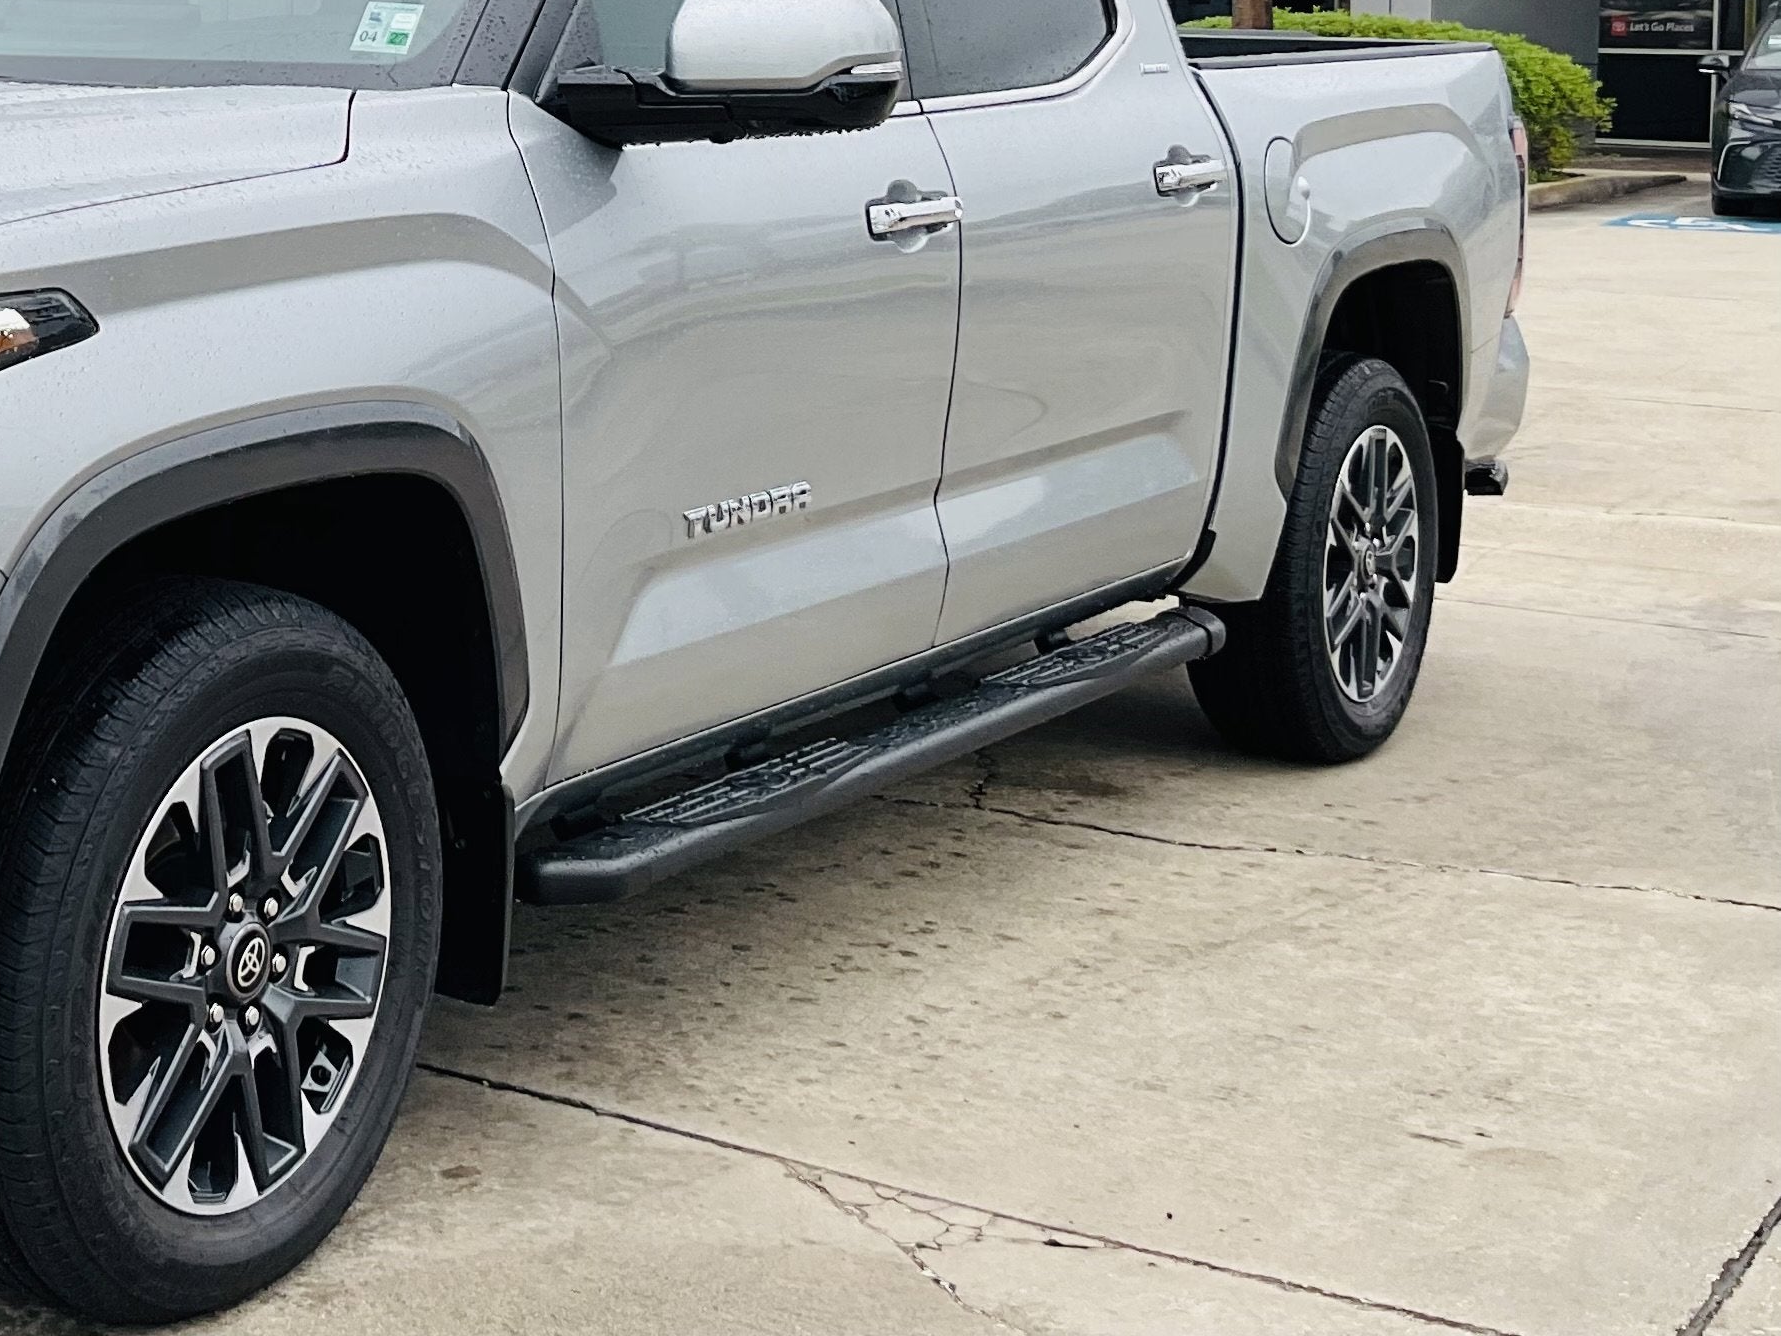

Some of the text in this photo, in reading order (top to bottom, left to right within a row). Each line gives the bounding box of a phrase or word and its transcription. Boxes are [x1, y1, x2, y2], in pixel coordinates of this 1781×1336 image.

[1629, 22, 1695, 32] Let's Go Places
[359, 30, 378, 42] 04
[389, 32, 409, 44] 27
[683, 480, 812, 540] TUNDRA
